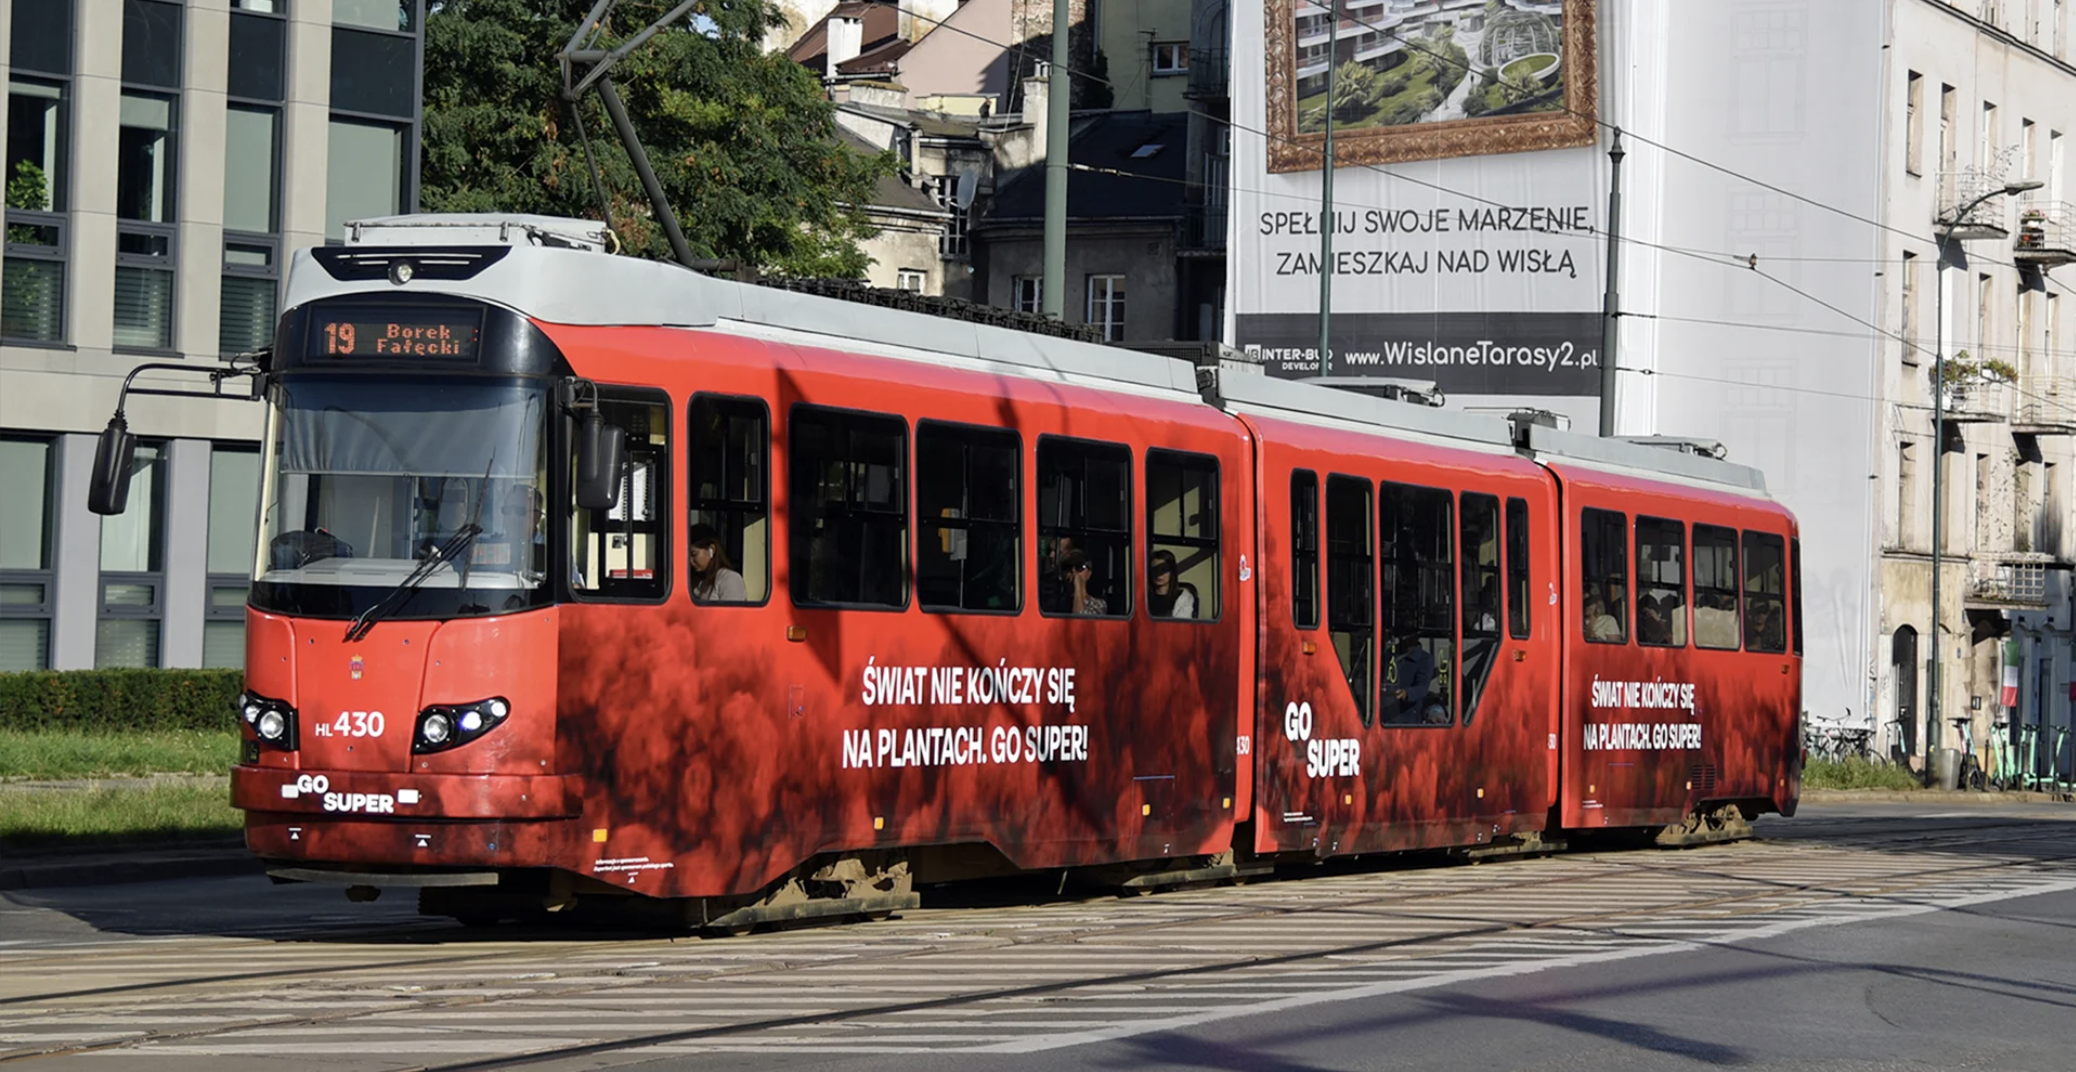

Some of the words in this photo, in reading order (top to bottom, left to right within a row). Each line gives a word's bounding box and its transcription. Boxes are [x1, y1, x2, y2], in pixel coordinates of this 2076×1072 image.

[1364, 208, 1450, 233] SWOJE
[1458, 206, 1594, 234] MARZENIE,
[1437, 249, 1489, 273] NAD
[1497, 249, 1577, 279] WISŁĄ
[324, 322, 355, 354] 19
[387, 323, 451, 339] Borek
[377, 338, 460, 356] Fałęcki
[1344, 340, 1598, 372] www.WislaneTarasy2.pl
[1281, 362, 1333, 370] DEVELOR
[862, 656, 927, 705] ŚWIAT
[931, 667, 963, 704] NIE
[967, 658, 1045, 704] KOŃCZY
[1047, 668, 1076, 712] SIĘ
[1591, 673, 1623, 708] ŚWIAT
[1624, 682, 1640, 708] NIE
[1641, 675, 1680, 708] KOŃCZY
[1680, 683, 1695, 715] SIĘ
[1285, 701, 1312, 742] GO
[1583, 723, 1598, 750] NA
[1599, 723, 1652, 750] PLANTACH.
[1652, 723, 1668, 750] GO
[1668, 723, 1701, 749] SUPER!
[842, 729, 873, 768] NA
[877, 727, 987, 767] PLANTACH.
[991, 726, 1021, 763] GO
[1024, 725, 1088, 762] SUPER!
[1306, 738, 1360, 778] SUPER
[297, 774, 329, 794] GO
[323, 792, 394, 813] SUPER
